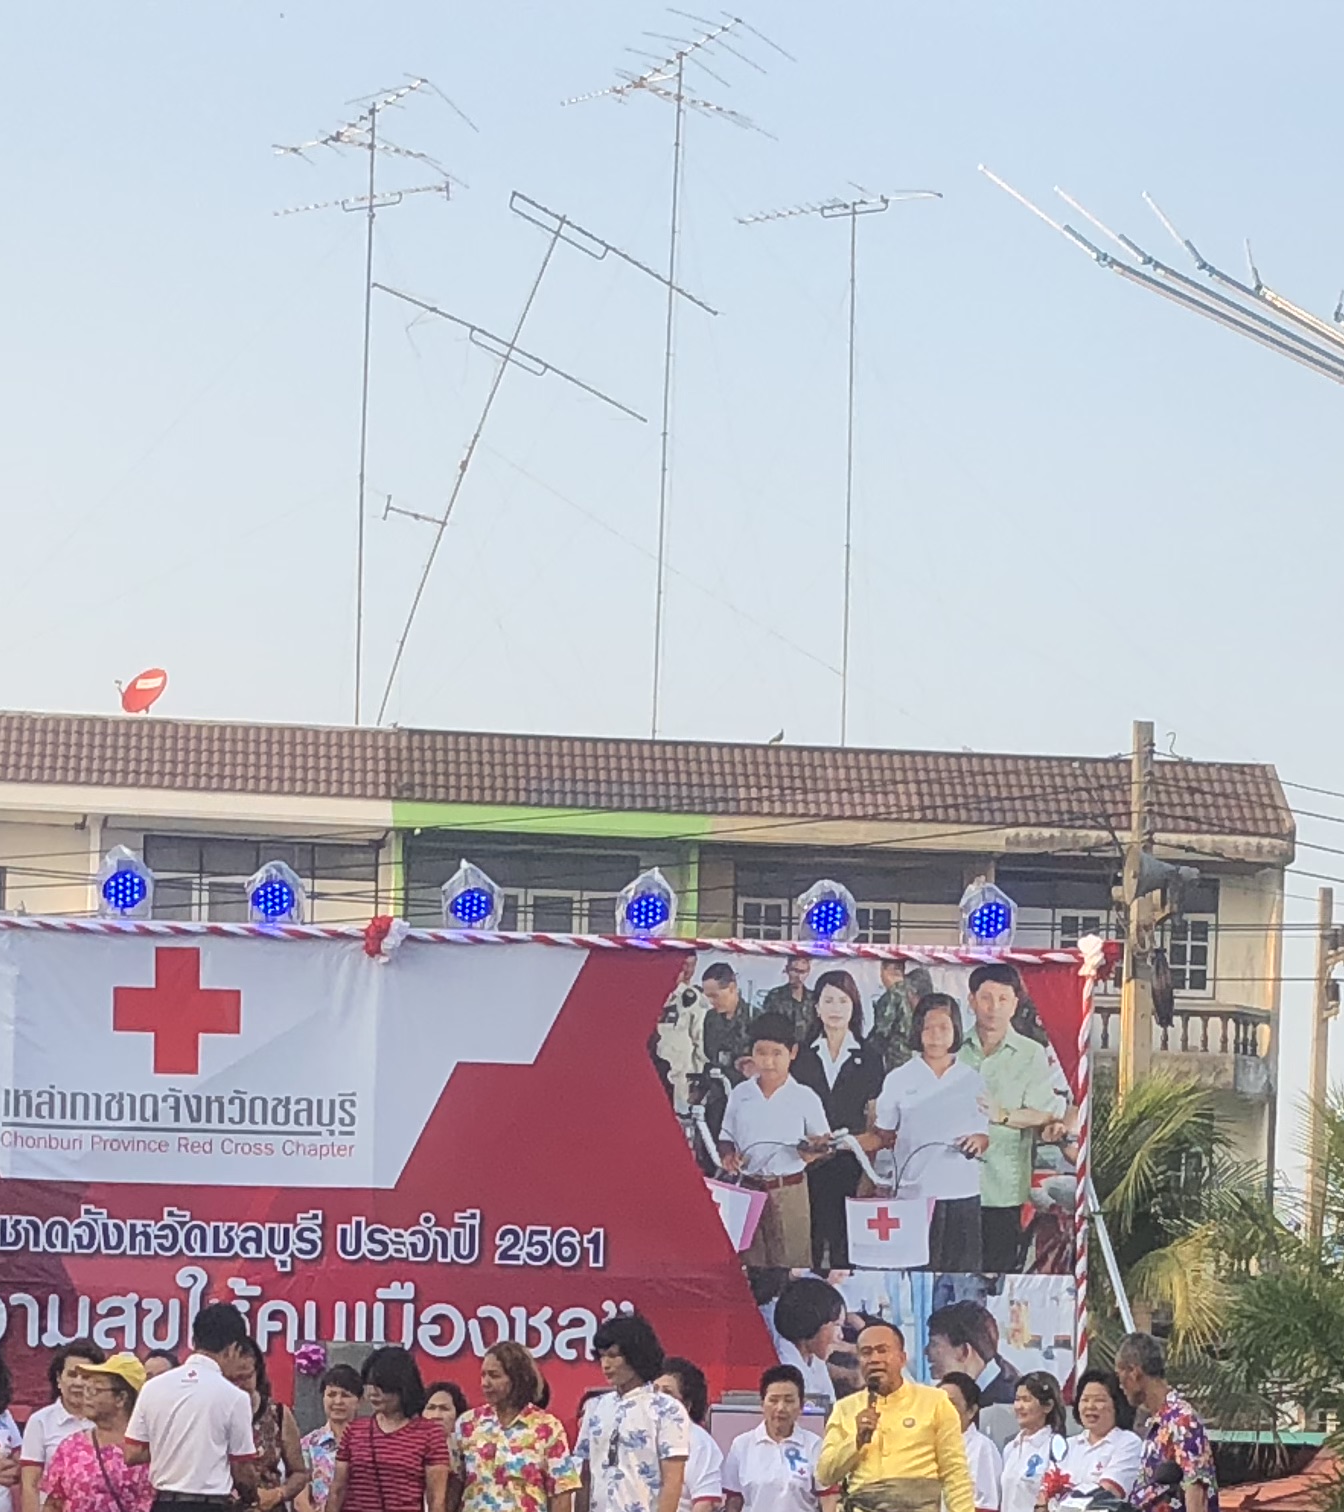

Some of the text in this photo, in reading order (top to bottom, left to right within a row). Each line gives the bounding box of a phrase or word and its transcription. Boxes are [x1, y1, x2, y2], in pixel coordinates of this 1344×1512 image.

[2, 1084, 357, 1137] เหล่ากาชาดจังหวัดชลบุรี
[0, 1131, 356, 1161] Chonburi Province Red Cross Chapter
[337, 1208, 482, 1265] ประจำปี
[493, 1225, 606, 1267] 2561
